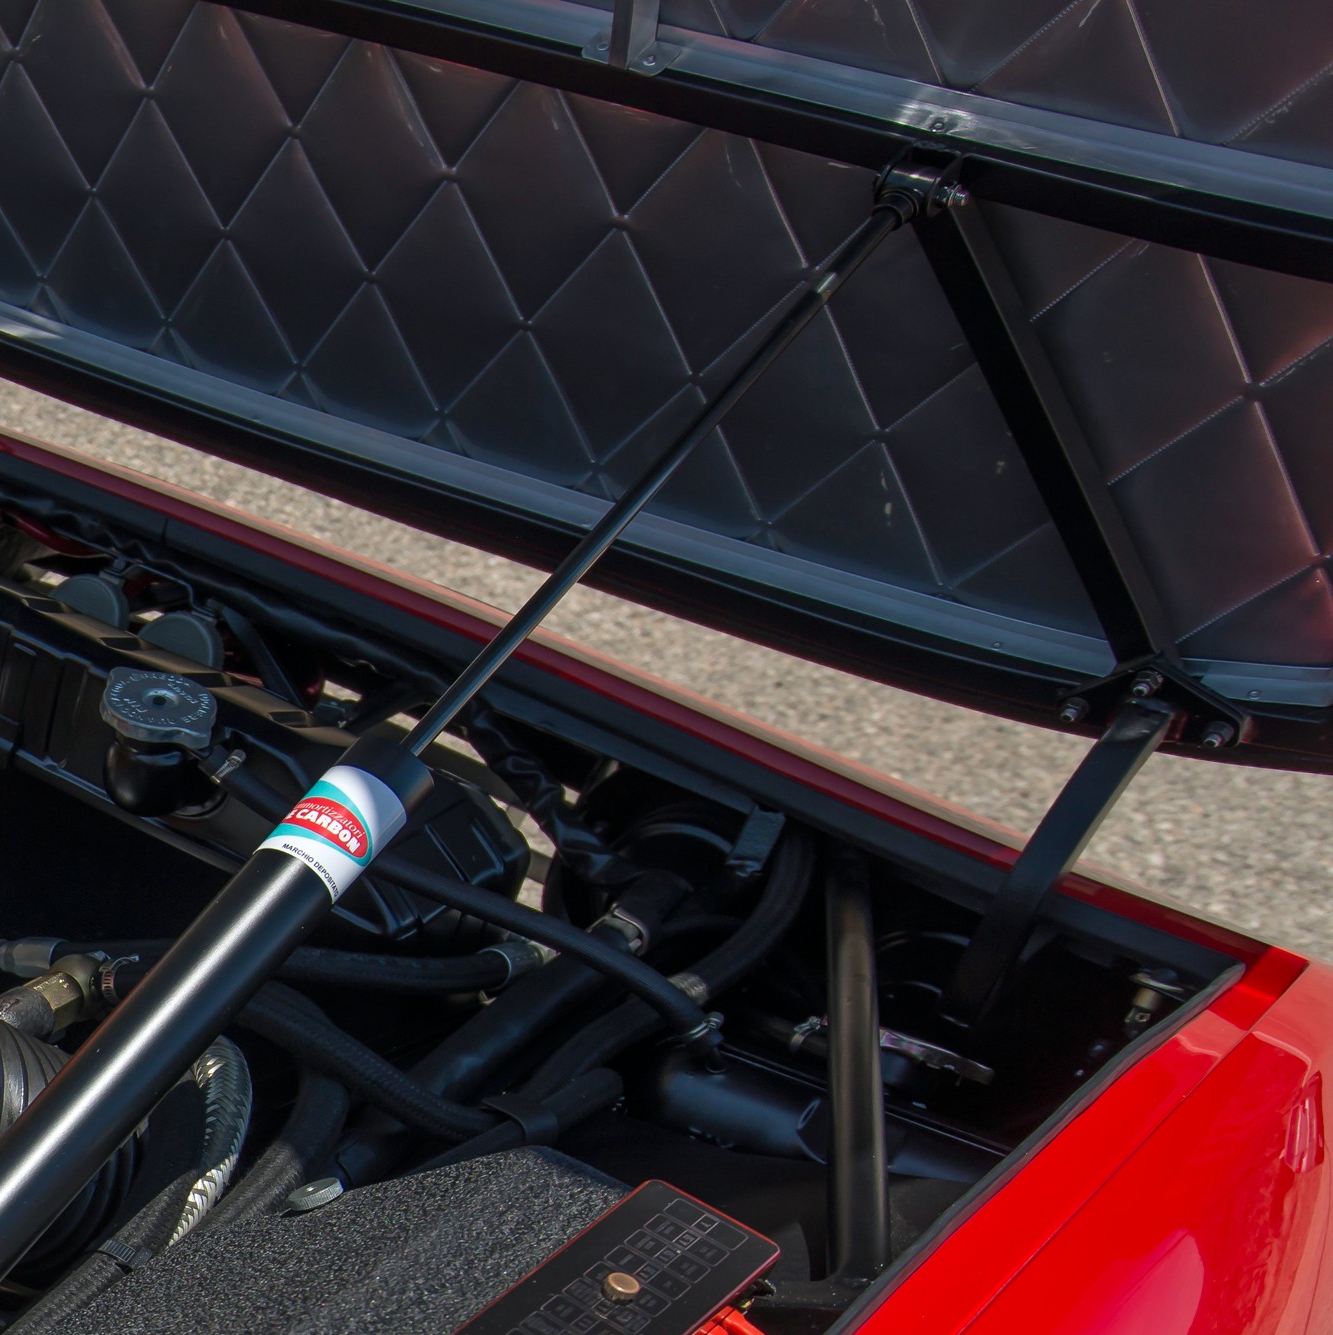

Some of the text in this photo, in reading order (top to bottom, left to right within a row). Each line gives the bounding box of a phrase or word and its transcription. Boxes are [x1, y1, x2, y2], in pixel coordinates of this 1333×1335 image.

[296, 809, 360, 853] CARBON
[282, 843, 338, 897] MARCHIO DEPOSITATO
